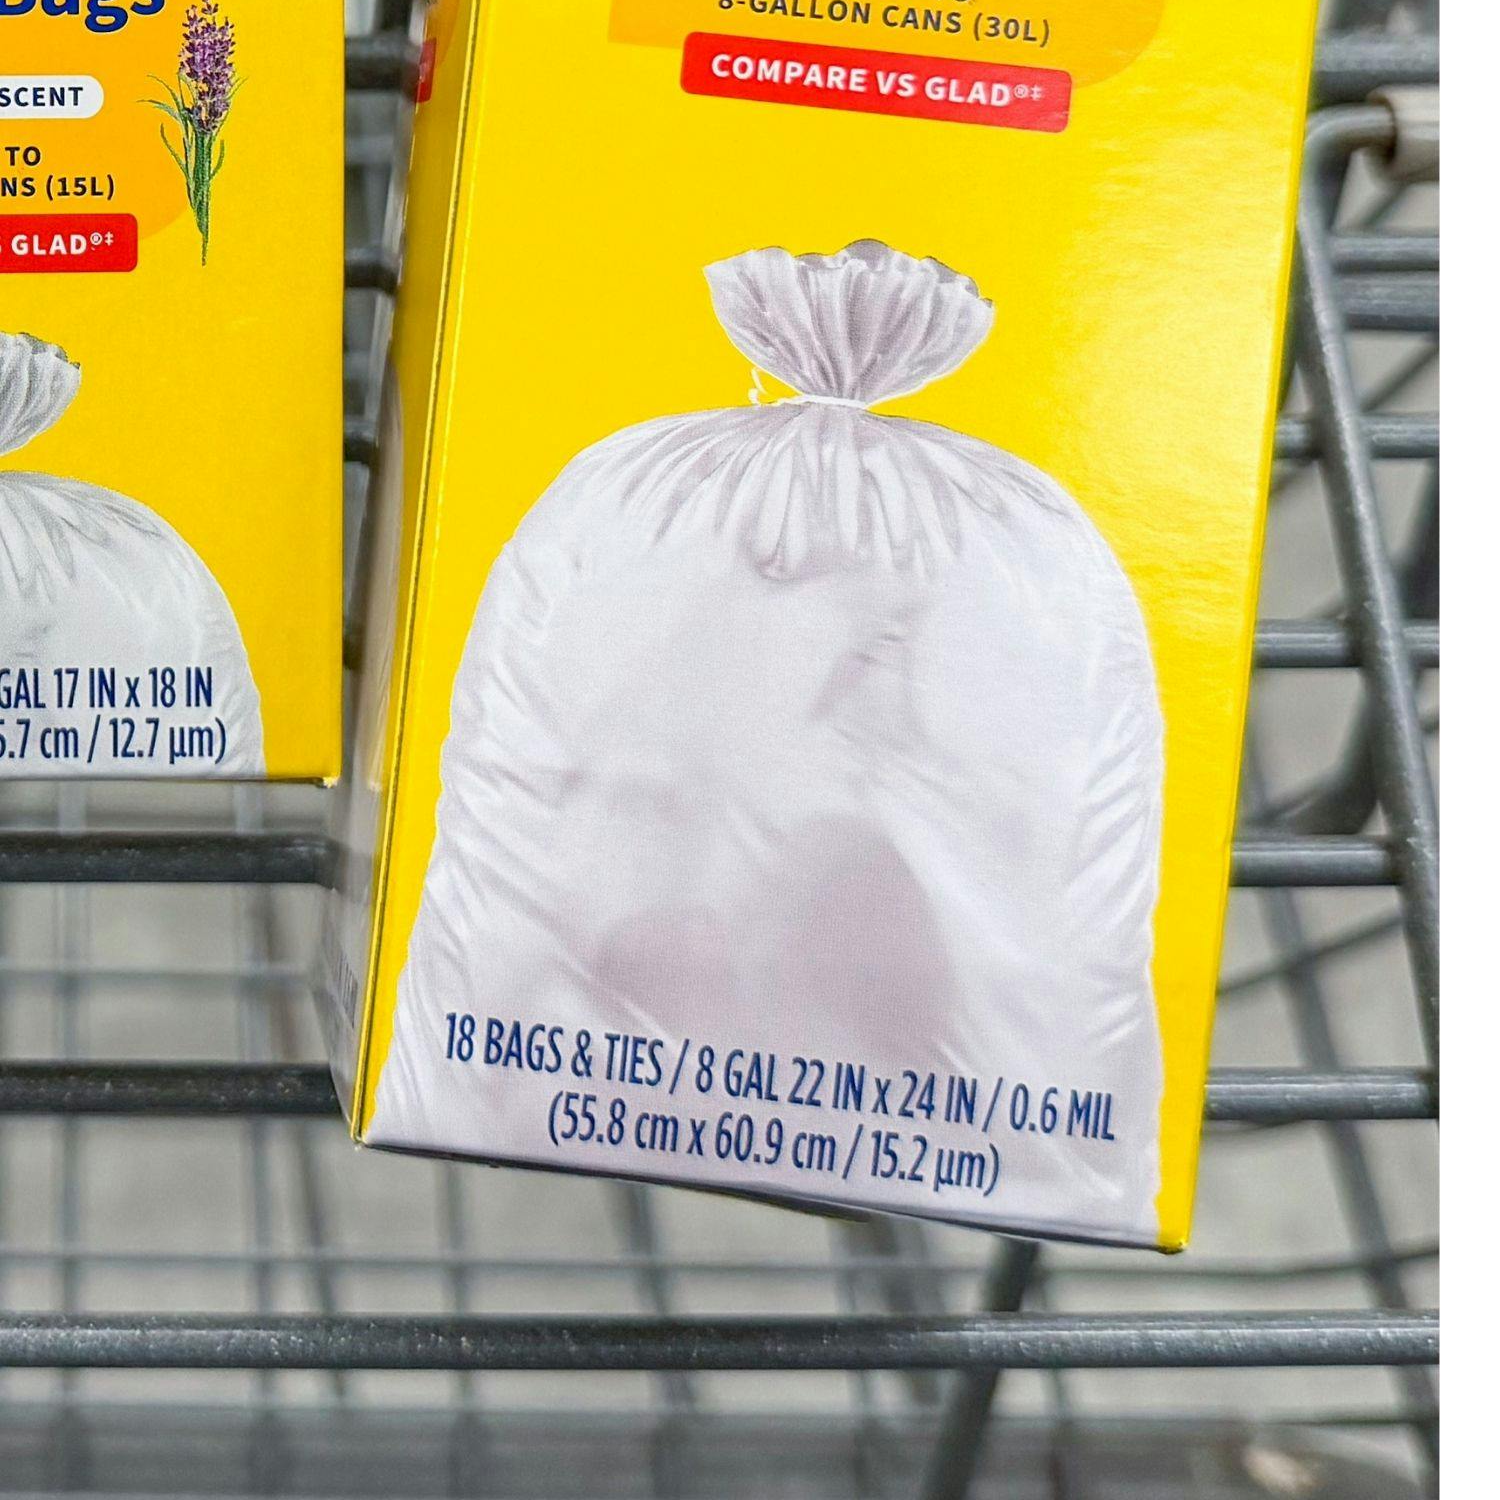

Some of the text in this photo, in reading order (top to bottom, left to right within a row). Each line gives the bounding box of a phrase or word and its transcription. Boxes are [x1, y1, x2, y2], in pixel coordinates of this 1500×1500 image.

[882, 6, 961, 34] CANS
[974, 11, 1051, 47] (30L)
[711, 53, 865, 92] COMPARE
[875, 71, 915, 98] VS
[0, 87, 83, 107] SCENT
[46, 176, 114, 198] (15L)
[54, 669, 176, 707] 17 18
[40, 728, 79, 758] cm
[110, 719, 159, 758] 12.7
[483, 1019, 1114, 1141] BAGS GAL 22 24 0.6 MIL
[549, 1089, 625, 1146] (55.8
[714, 1114, 782, 1166] 60.9
[870, 1131, 927, 1181] 15.2
